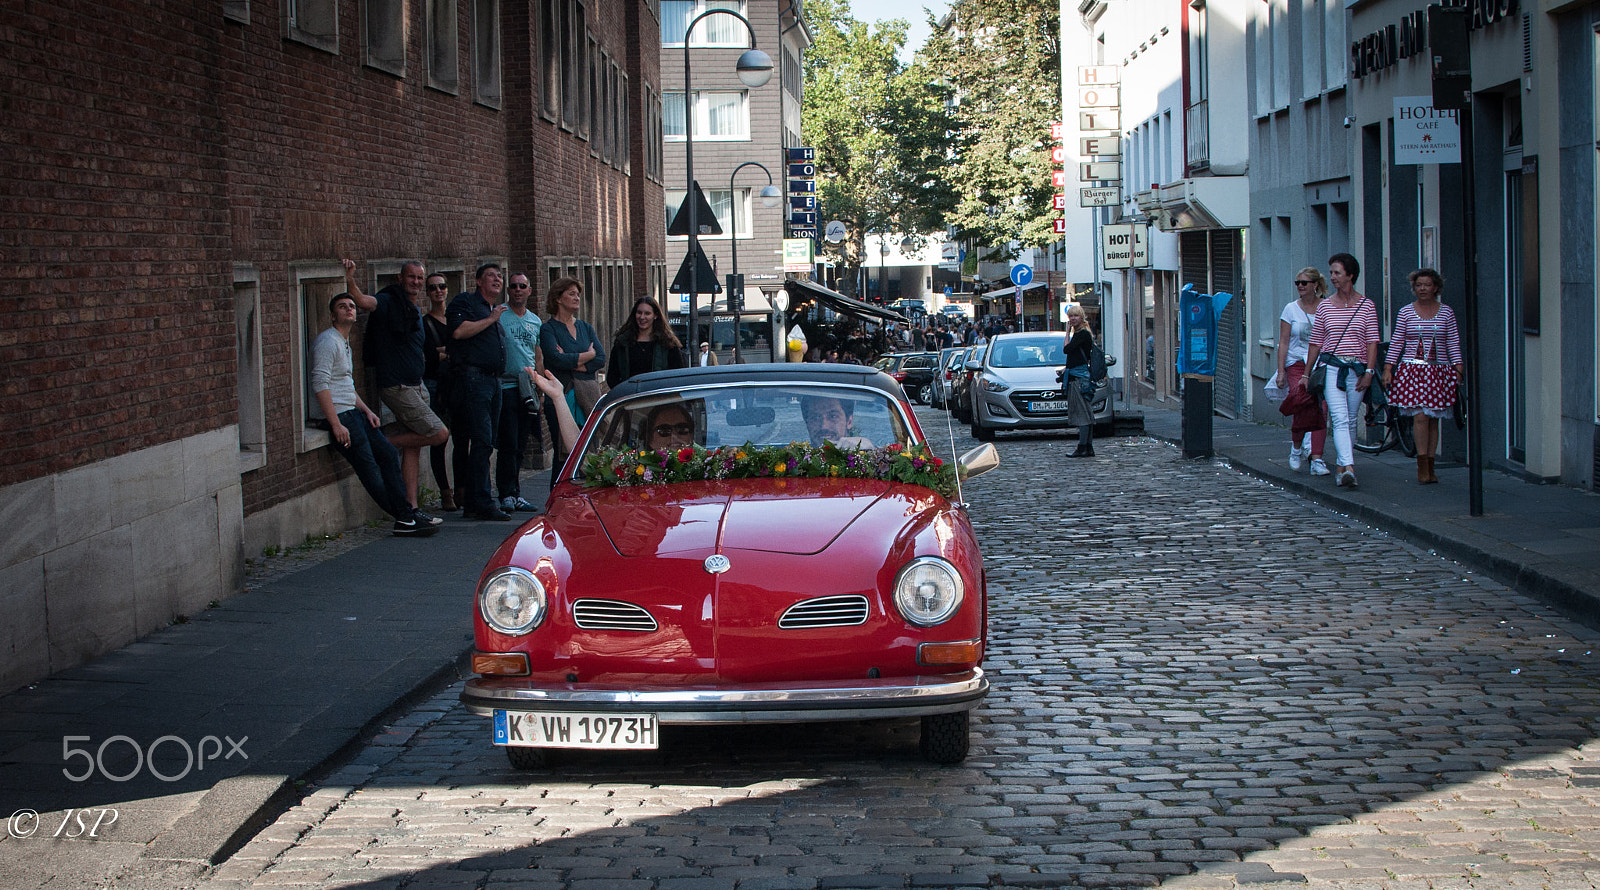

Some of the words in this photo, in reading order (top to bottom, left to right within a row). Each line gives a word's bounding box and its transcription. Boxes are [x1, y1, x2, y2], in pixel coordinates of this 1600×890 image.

[1399, 106, 1456, 120] HOTEL
[1085, 69, 1099, 179] HOTEL
[1416, 119, 1439, 130] CAFÉ
[804, 149, 814, 223] HOTEL
[793, 230, 815, 239] SION
[1109, 234, 1141, 246] HOTL
[1107, 251, 1145, 260] BÜRGEOF
[497, 730, 504, 739] D
[509, 715, 524, 741] K
[541, 716, 571, 743] VW
[578, 717, 655, 744] 1973H
